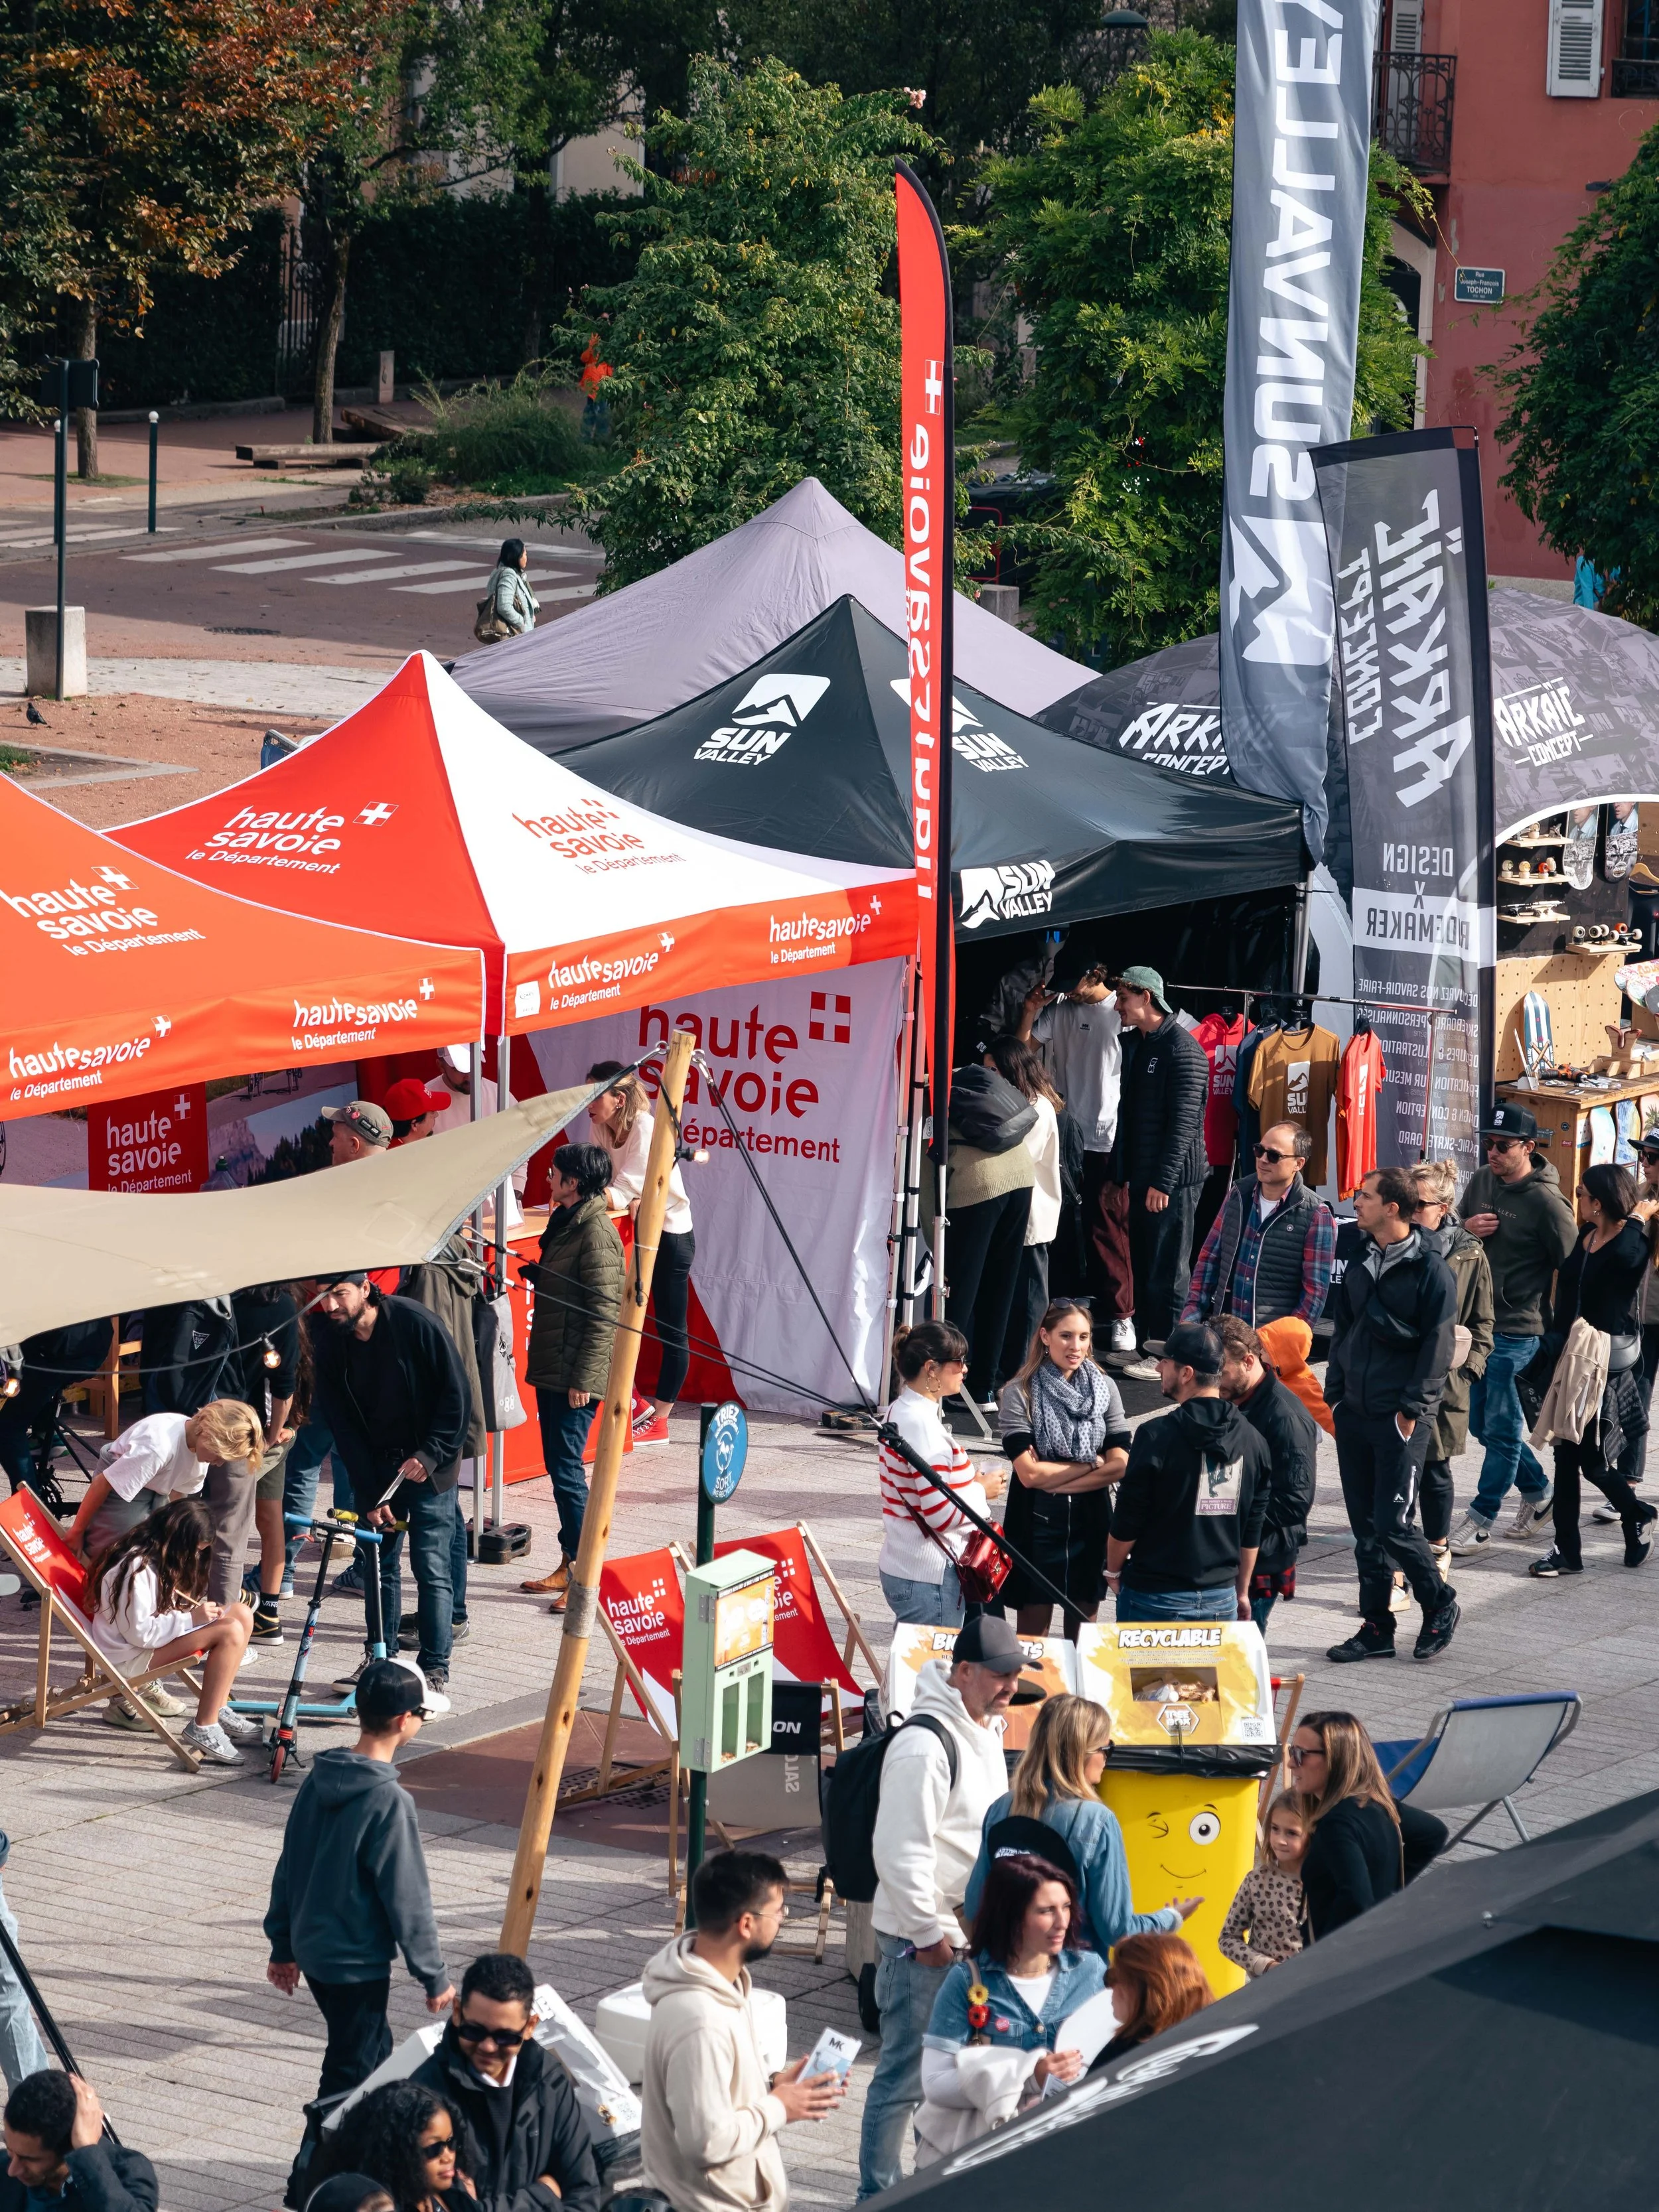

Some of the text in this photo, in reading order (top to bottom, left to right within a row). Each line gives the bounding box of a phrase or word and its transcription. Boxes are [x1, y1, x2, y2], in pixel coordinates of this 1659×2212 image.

[1466, 286, 1492, 295] TOCHON
[701, 727, 792, 754] SUN
[1119, 703, 1222, 752] ARK
[693, 748, 772, 766] VALLEY
[952, 732, 1017, 760] SUN
[1528, 730, 1582, 767] CONCEPT
[970, 755, 1029, 772] VALLEY
[224, 805, 344, 832] haute
[512, 807, 605, 839] haute
[205, 829, 341, 855] savoie
[549, 834, 644, 859] savoie
[185, 849, 340, 874] le Département
[575, 853, 686, 875] le Département
[997, 859, 1056, 901] SUN
[0, 878, 115, 918] haute
[1000, 891, 1052, 920] VALLEY
[37, 906, 159, 939] savoie
[64, 929, 206, 957] le Département
[770, 942, 836, 964] le Département
[550, 983, 621, 1010] le Département
[292, 1028, 376, 1050] le Département
[638, 1004, 798, 1064] haute
[10, 1070, 103, 1101] le Département
[640, 1060, 820, 1119] savoie
[1213, 1075, 1234, 1087] SUN
[106, 1111, 171, 1149] haute
[680, 1118, 840, 1163] épartement
[108, 1138, 182, 1176] savoie
[121, 1170, 192, 1193] Département
[715, 1405, 740, 1427] TRIEZ
[715, 1471, 732, 1490] SORT
[607, 1592, 654, 1618] haute
[612, 1610, 665, 1635] savoie
[621, 1628, 670, 1646] e Département
[1118, 1628, 1222, 1648] RECYCLABLE
